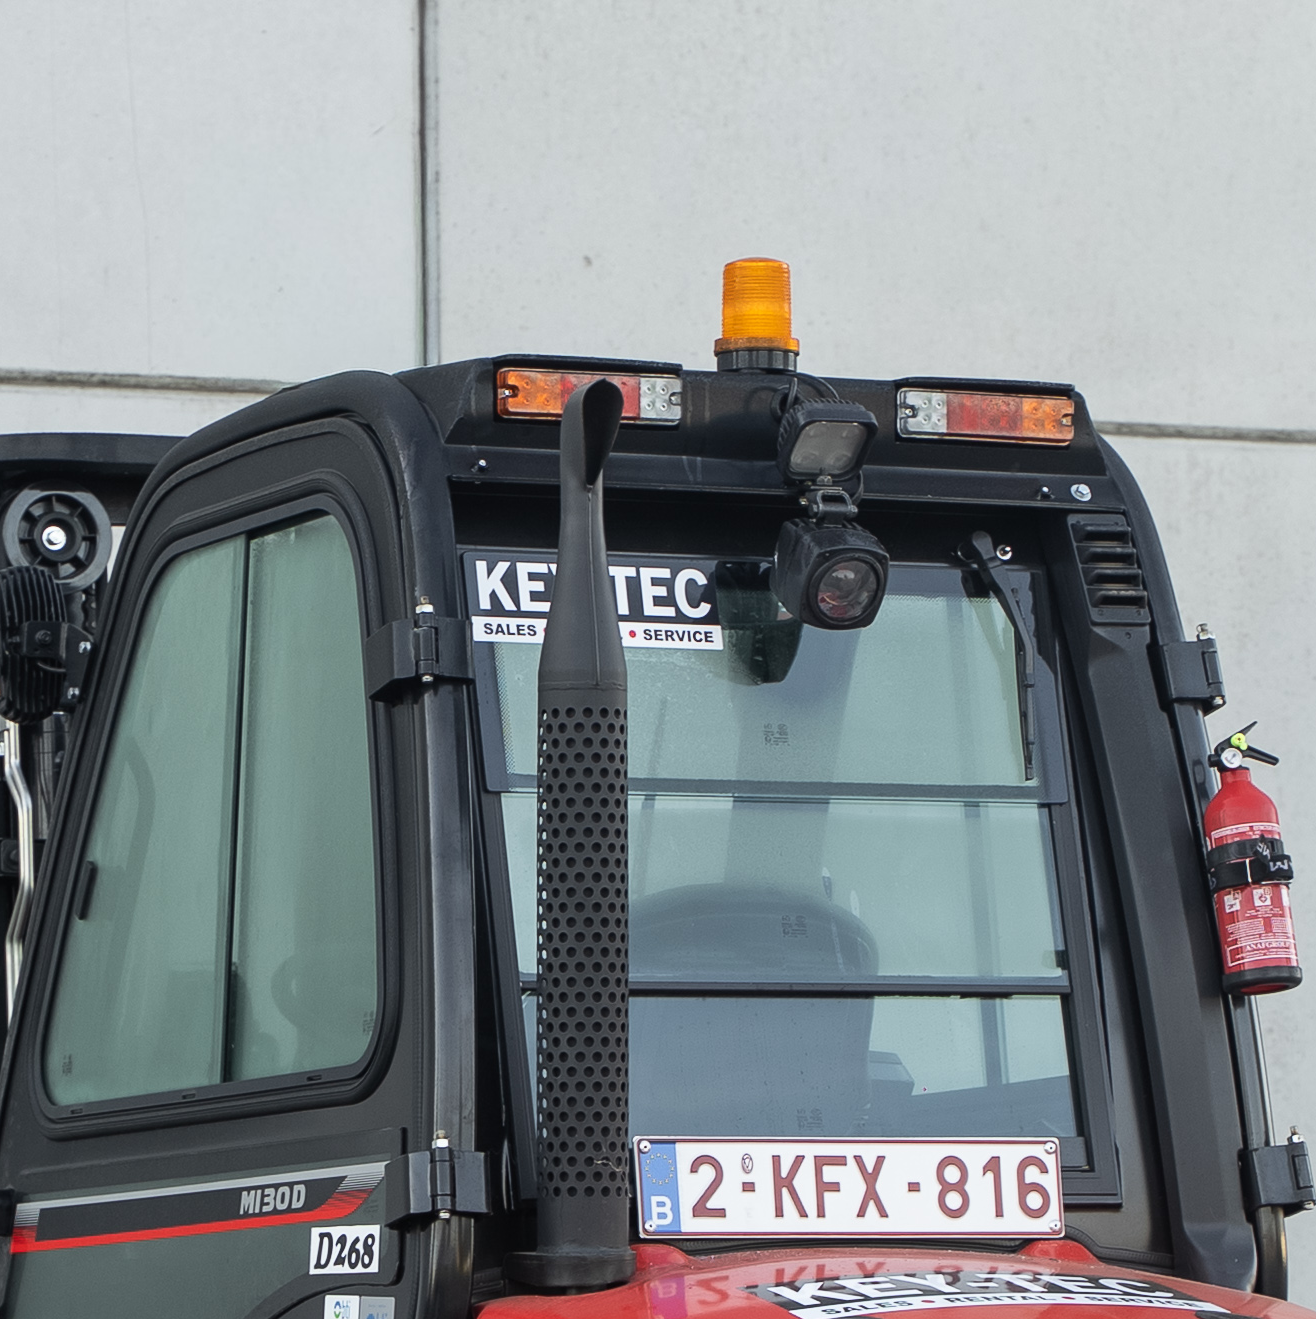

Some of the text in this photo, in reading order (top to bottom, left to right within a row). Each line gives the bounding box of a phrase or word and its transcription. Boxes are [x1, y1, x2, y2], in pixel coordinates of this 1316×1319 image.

[474, 559, 712, 619] KETEC
[483, 622, 714, 644] SALES SERVICE
[689, 1154, 1051, 1219] 2-KFX-816
[650, 1195, 674, 1226] B
[313, 1231, 376, 1270] D268
[768, 1271, 1175, 1308] KEY-TEC
[821, 1293, 1205, 1316] SALES RENTAL SERVICE
